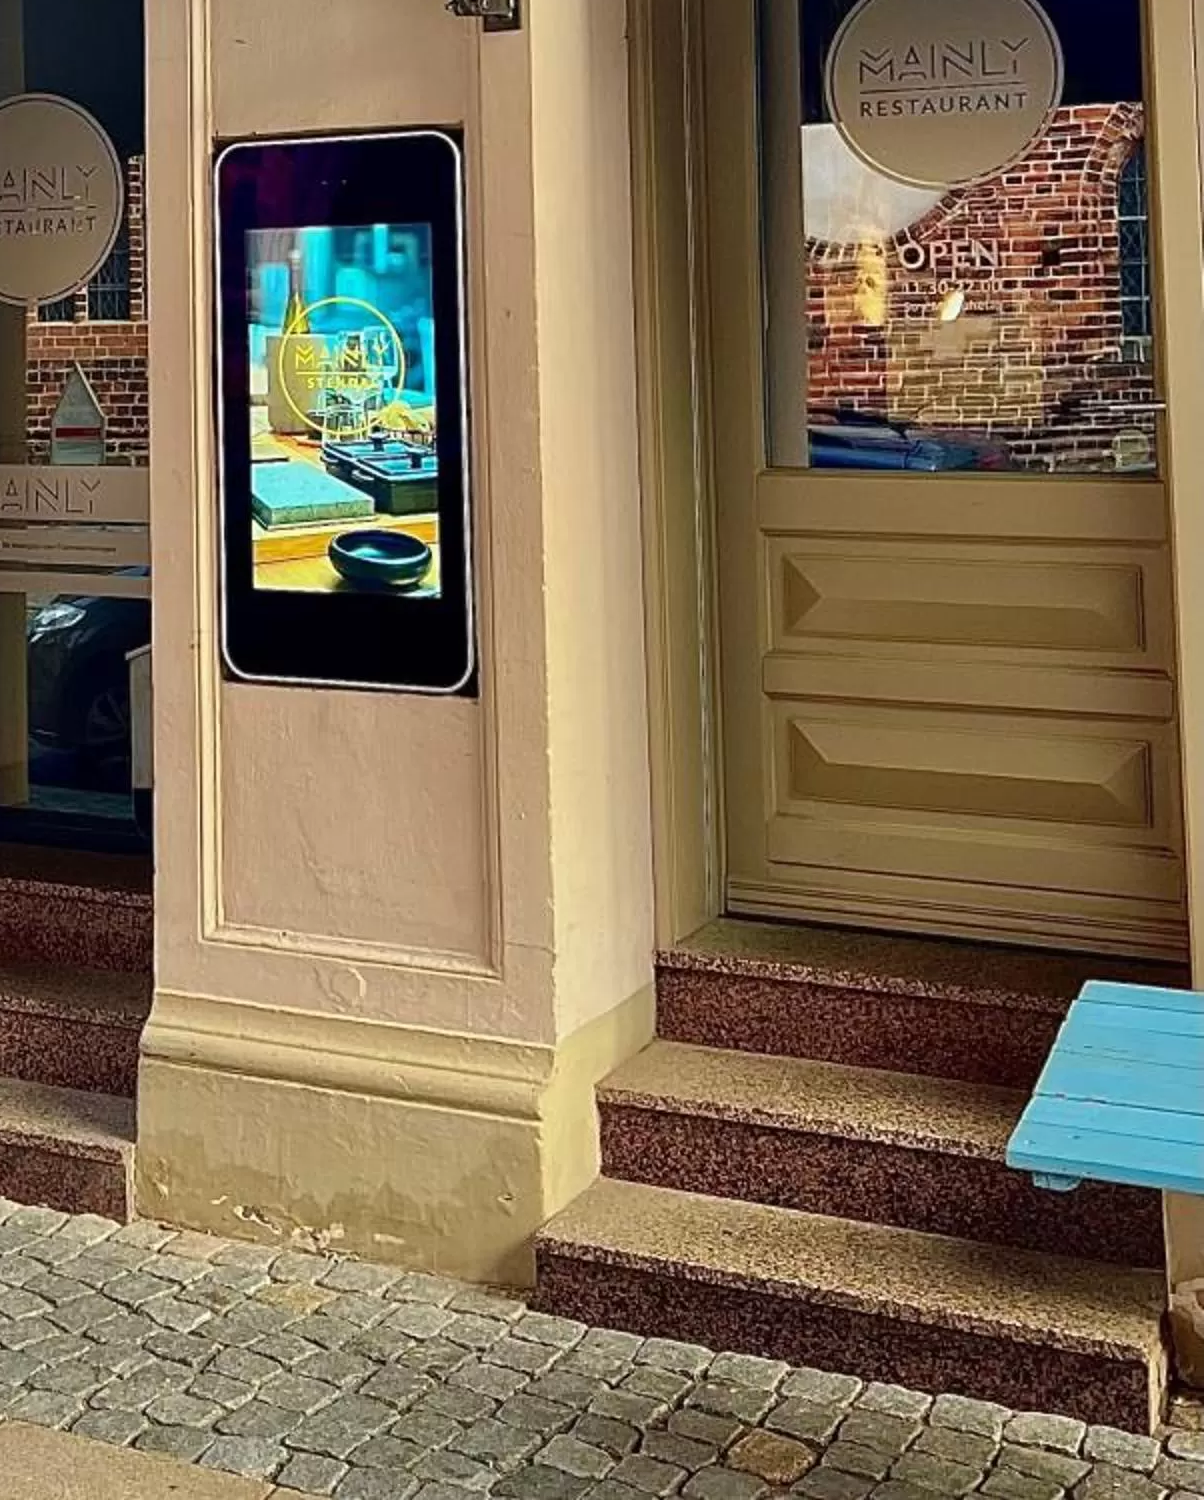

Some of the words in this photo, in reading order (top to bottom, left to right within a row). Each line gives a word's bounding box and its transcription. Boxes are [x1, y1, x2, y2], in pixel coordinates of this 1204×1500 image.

[859, 37, 1029, 85] MAINLY
[860, 92, 1028, 117] RESTAURANT
[899, 239, 999, 269] OPEN
